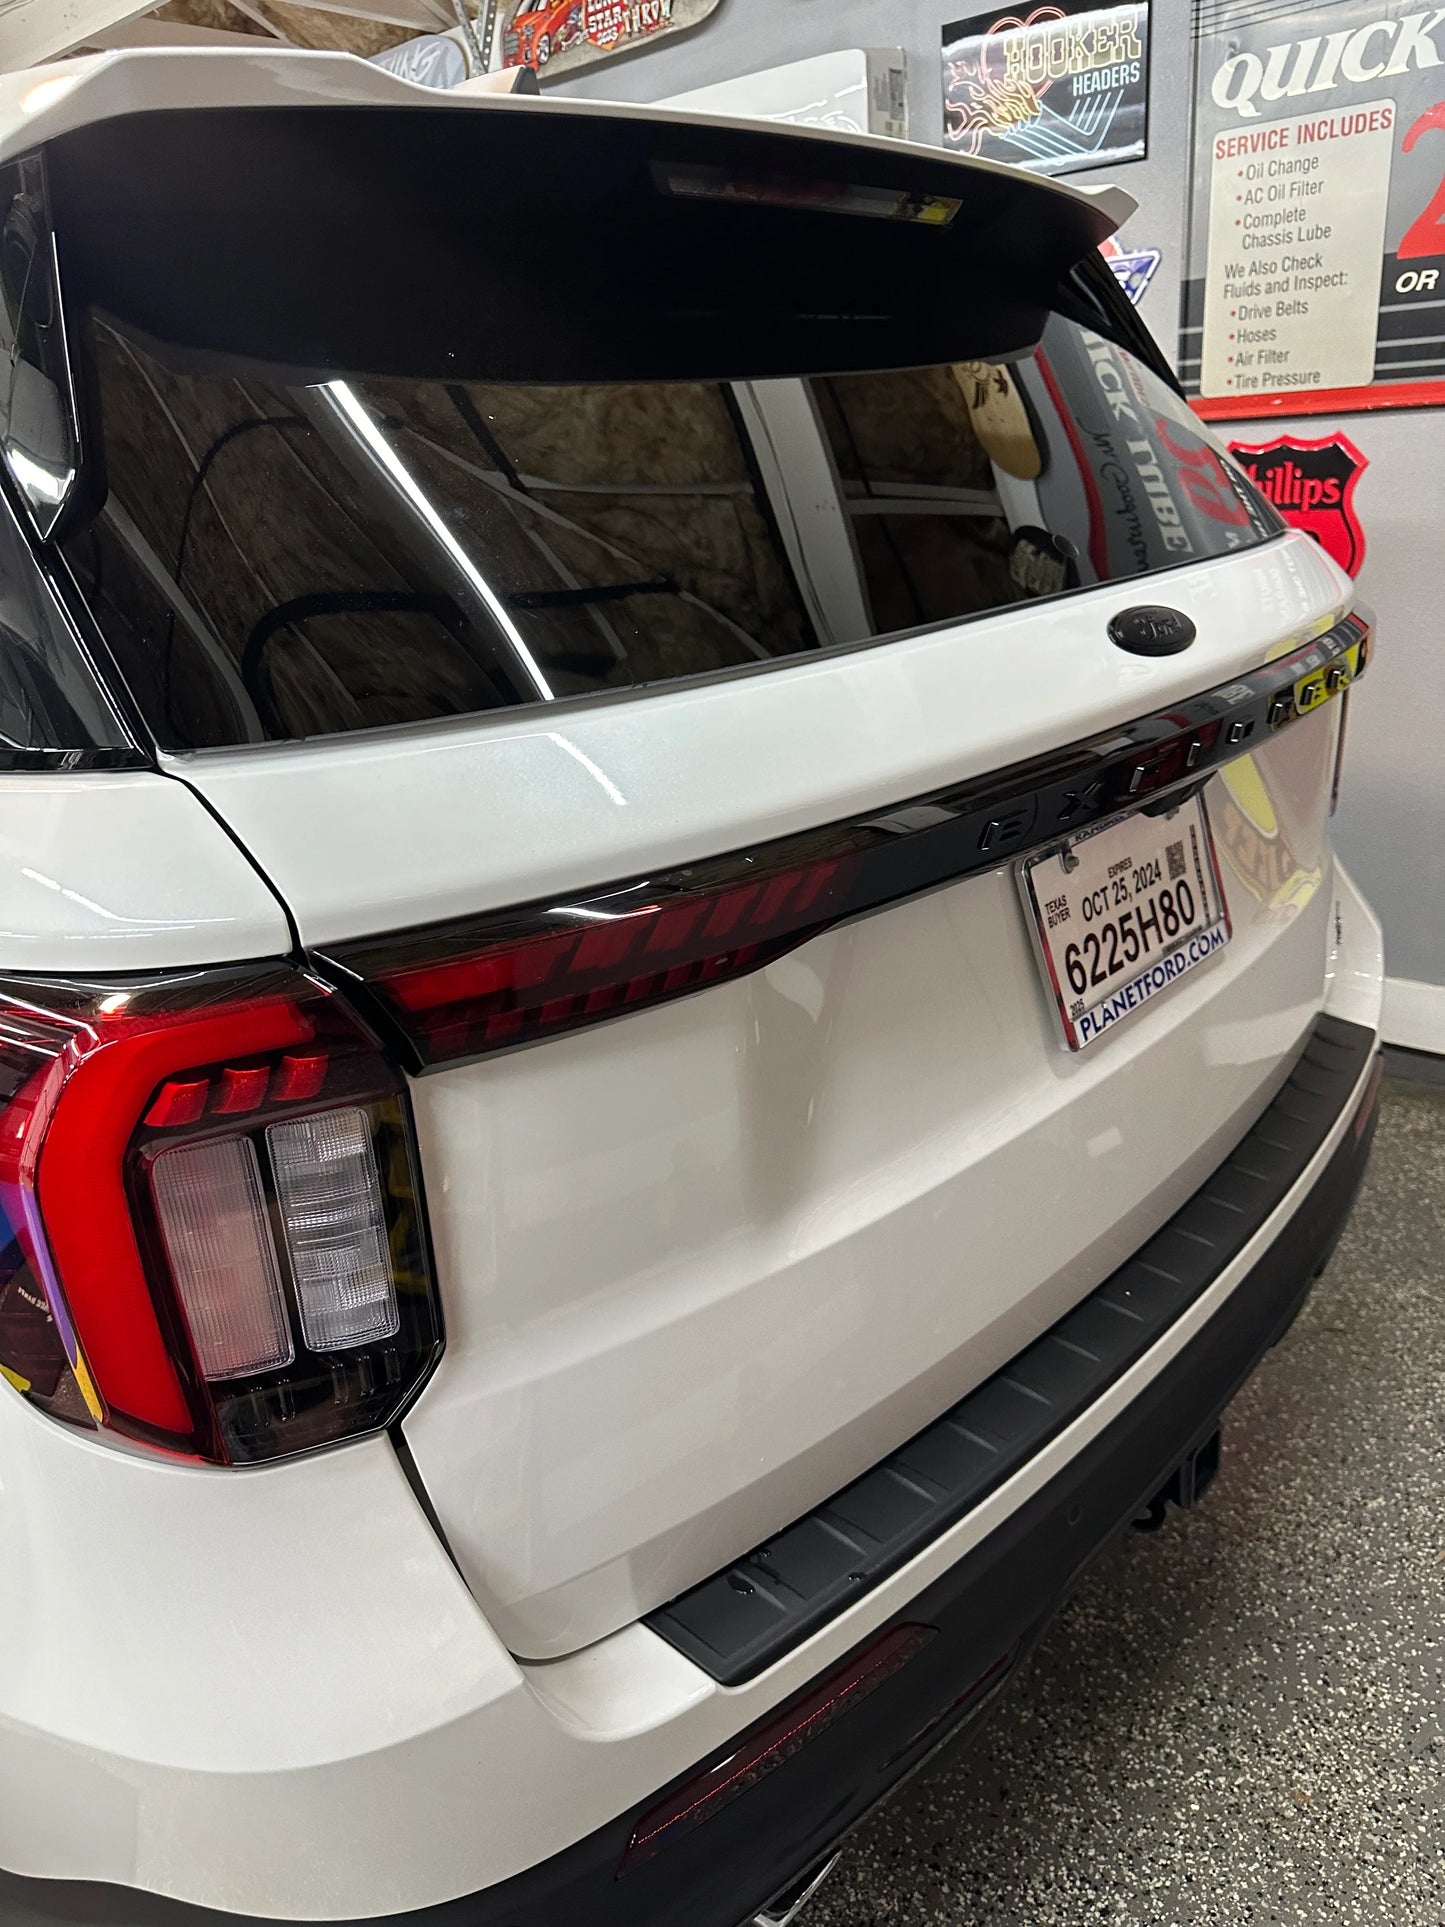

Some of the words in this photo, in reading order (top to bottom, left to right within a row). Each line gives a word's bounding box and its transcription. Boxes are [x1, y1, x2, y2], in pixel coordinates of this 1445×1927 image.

[589, 5, 622, 34] STAR
[1002, 13, 1143, 84] HOOKER
[1211, 8, 1445, 118] QUICK
[1072, 61, 1141, 97] HEADERS
[1215, 128, 1288, 160] SERVICE
[1297, 107, 1393, 145] INCLUDES
[1246, 164, 1264, 181] Oil
[1267, 155, 1319, 178] Change
[1244, 188, 1263, 206] AC
[1268, 184, 1285, 202] Oil
[1290, 180, 1324, 200] Filter
[1243, 207, 1306, 231] Complete
[1242, 228, 1294, 250] Chassis
[1297, 223, 1331, 243] Lube
[1225, 263, 1246, 280] We
[1249, 259, 1278, 277] Also
[1282, 253, 1323, 272] Check
[1224, 279, 1261, 299] Fluids
[1265, 277, 1290, 294] and
[1294, 271, 1348, 293] Inspect:
[1395, 269, 1439, 294] OR
[1238, 305, 1273, 322] Drive
[1276, 300, 1309, 318] Belts
[1236, 327, 1277, 345] Hoses
[1235, 350, 1255, 368] Air
[1257, 347, 1290, 365] Filter
[1235, 373, 1258, 390] Tire
[1262, 369, 1321, 387] Pressure
[1243, 460, 1341, 512] hillips
[1108, 857, 1132, 879] EXPIRES
[1082, 886, 1109, 922] OCT
[1111, 878, 1133, 905] 25,
[1132, 858, 1163, 895] 2024
[1045, 895, 1067, 914] TEXAS
[1048, 907, 1071, 929] BUYER
[1065, 879, 1195, 996] 6225H80
[1080, 926, 1224, 1042] PLANETFORD.COM
